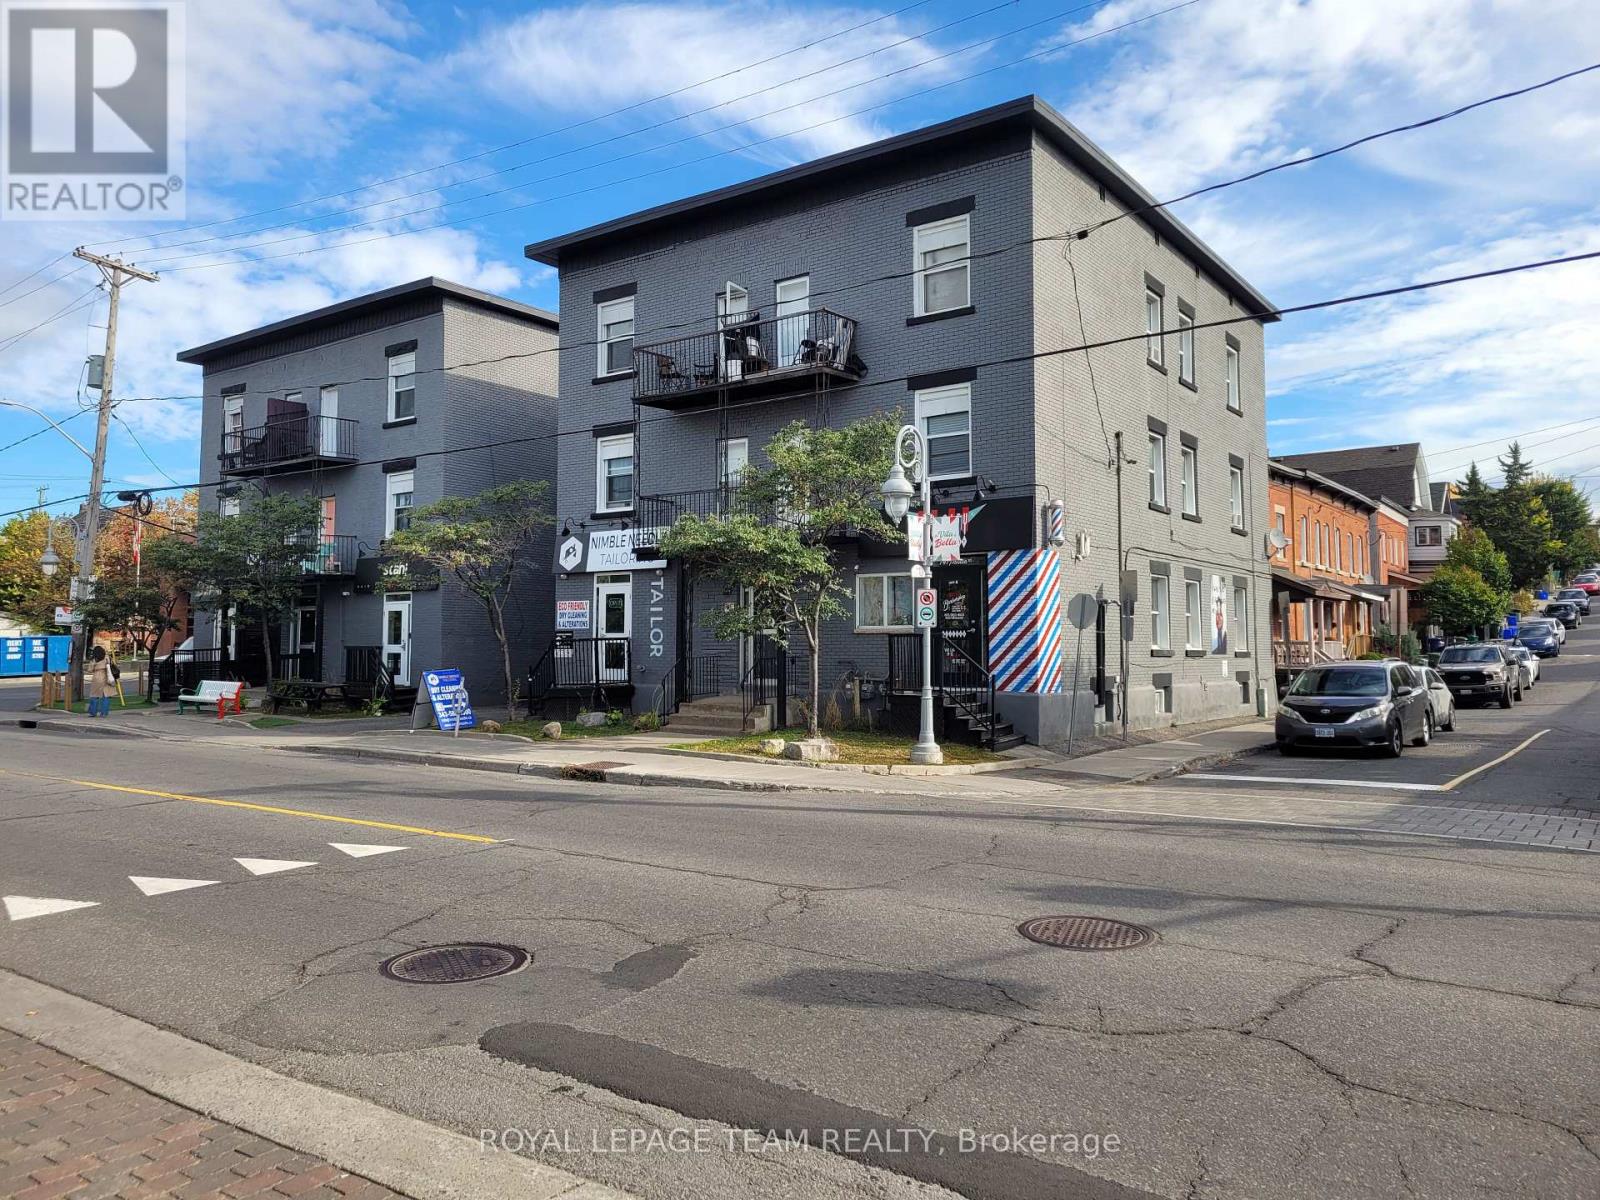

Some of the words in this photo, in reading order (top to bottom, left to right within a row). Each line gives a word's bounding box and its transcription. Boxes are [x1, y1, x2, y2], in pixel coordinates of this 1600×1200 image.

[591, 534, 626, 549] NIMBLE
[934, 538, 957, 548] Bella
[558, 602, 568, 611] ECO
[568, 601, 589, 610] FRIENDLY
[568, 611, 588, 619] CLEANING
[650, 577, 664, 657] TAILOR
[562, 620, 588, 628] ALTERATIONS
